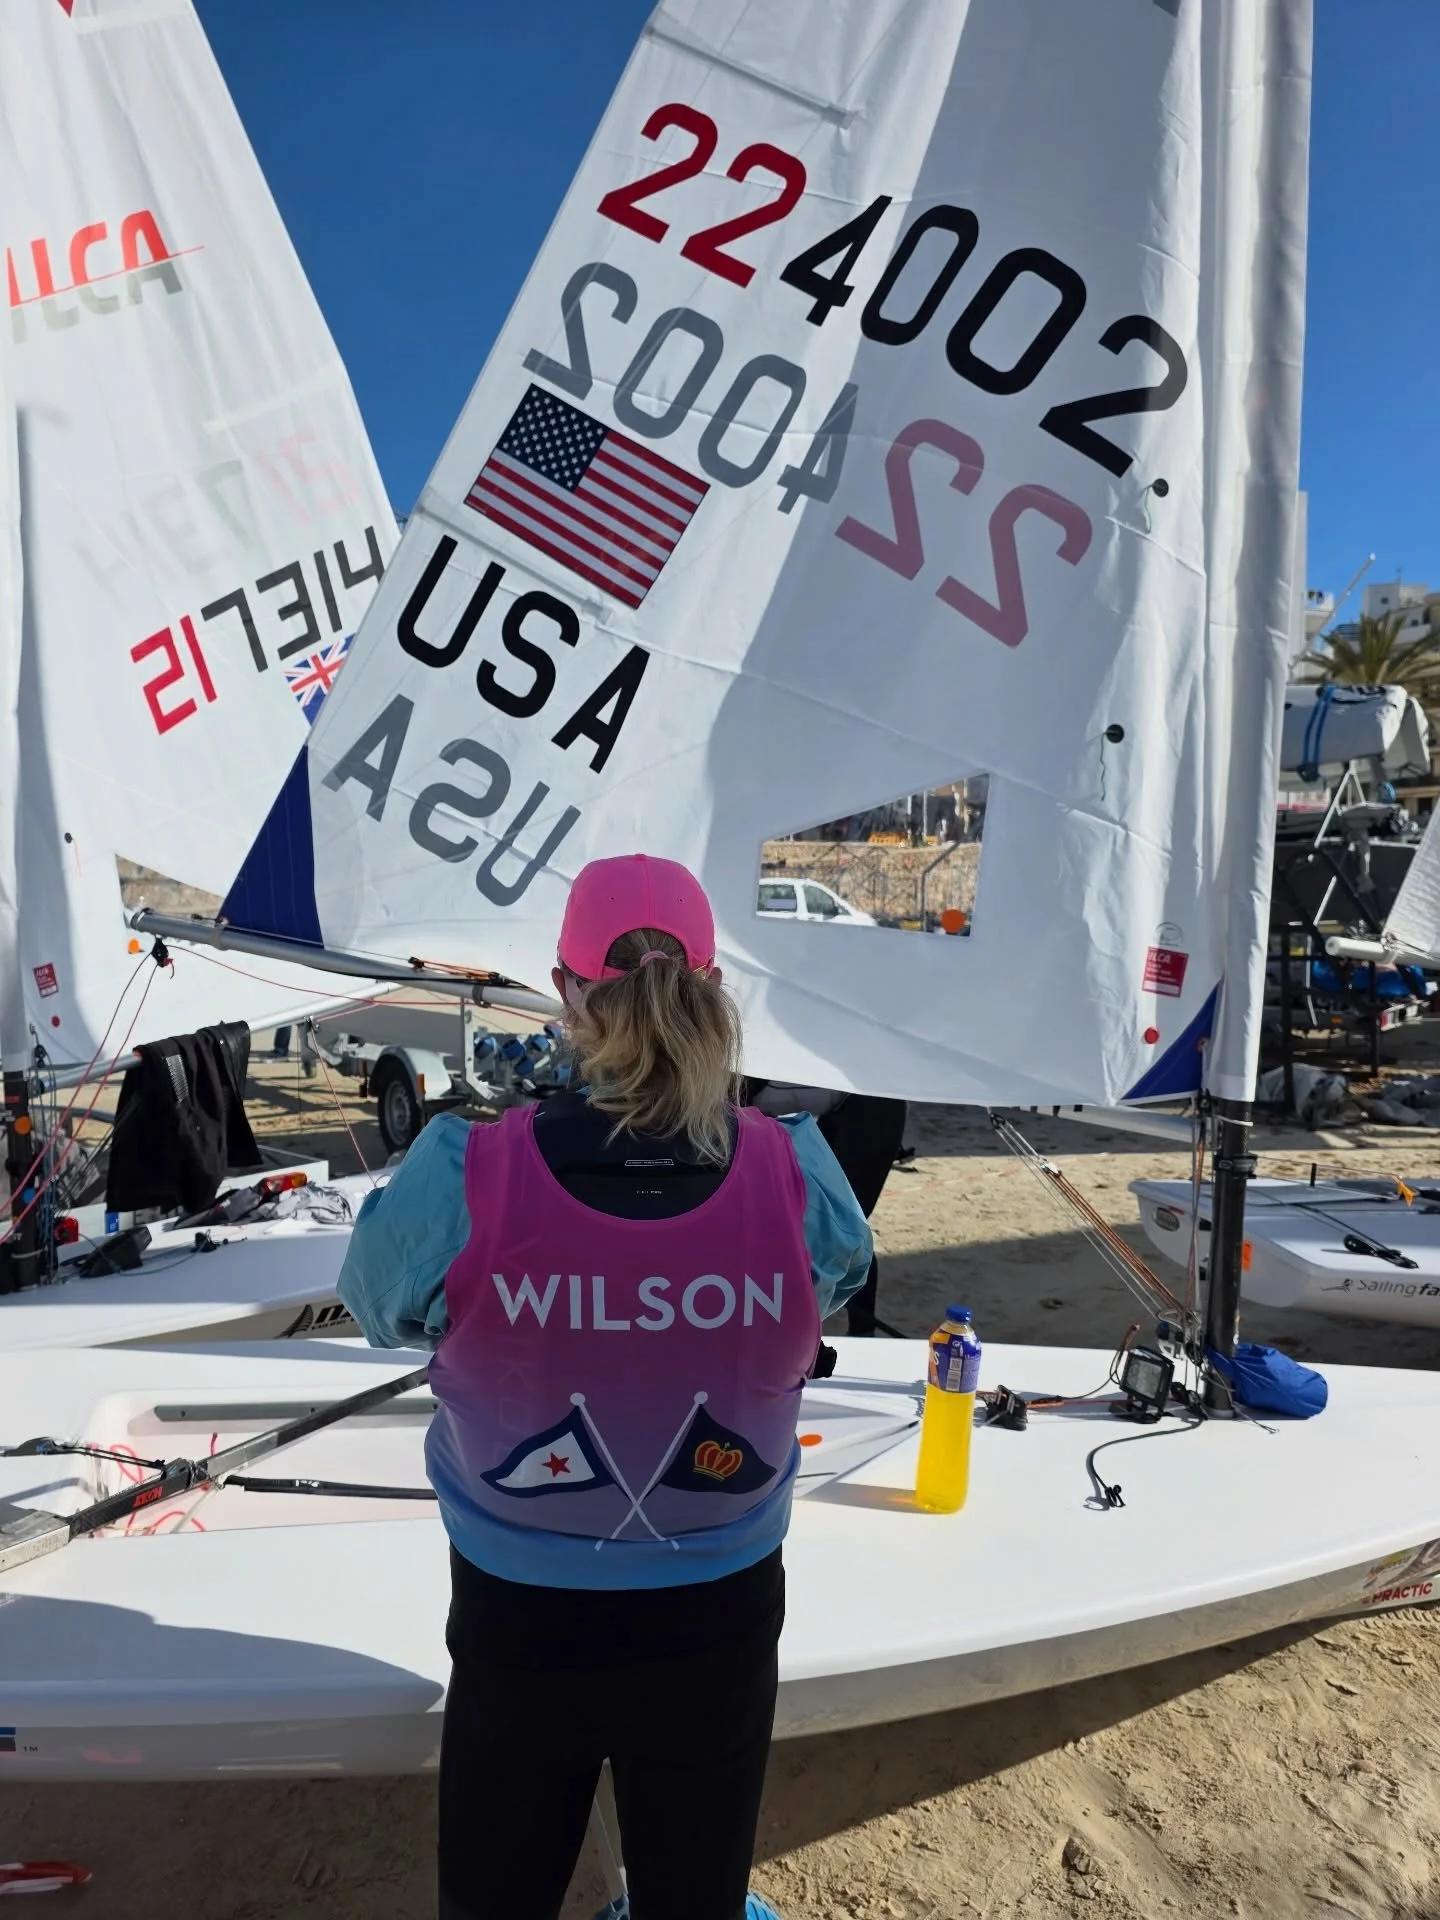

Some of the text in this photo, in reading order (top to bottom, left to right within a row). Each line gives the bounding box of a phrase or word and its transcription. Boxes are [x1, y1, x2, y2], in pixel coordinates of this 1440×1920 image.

[596, 103, 1189, 479] 224002
[130, 526, 386, 736] 217314
[397, 535, 651, 775] USA
[491, 1273, 784, 1331] WILSON
